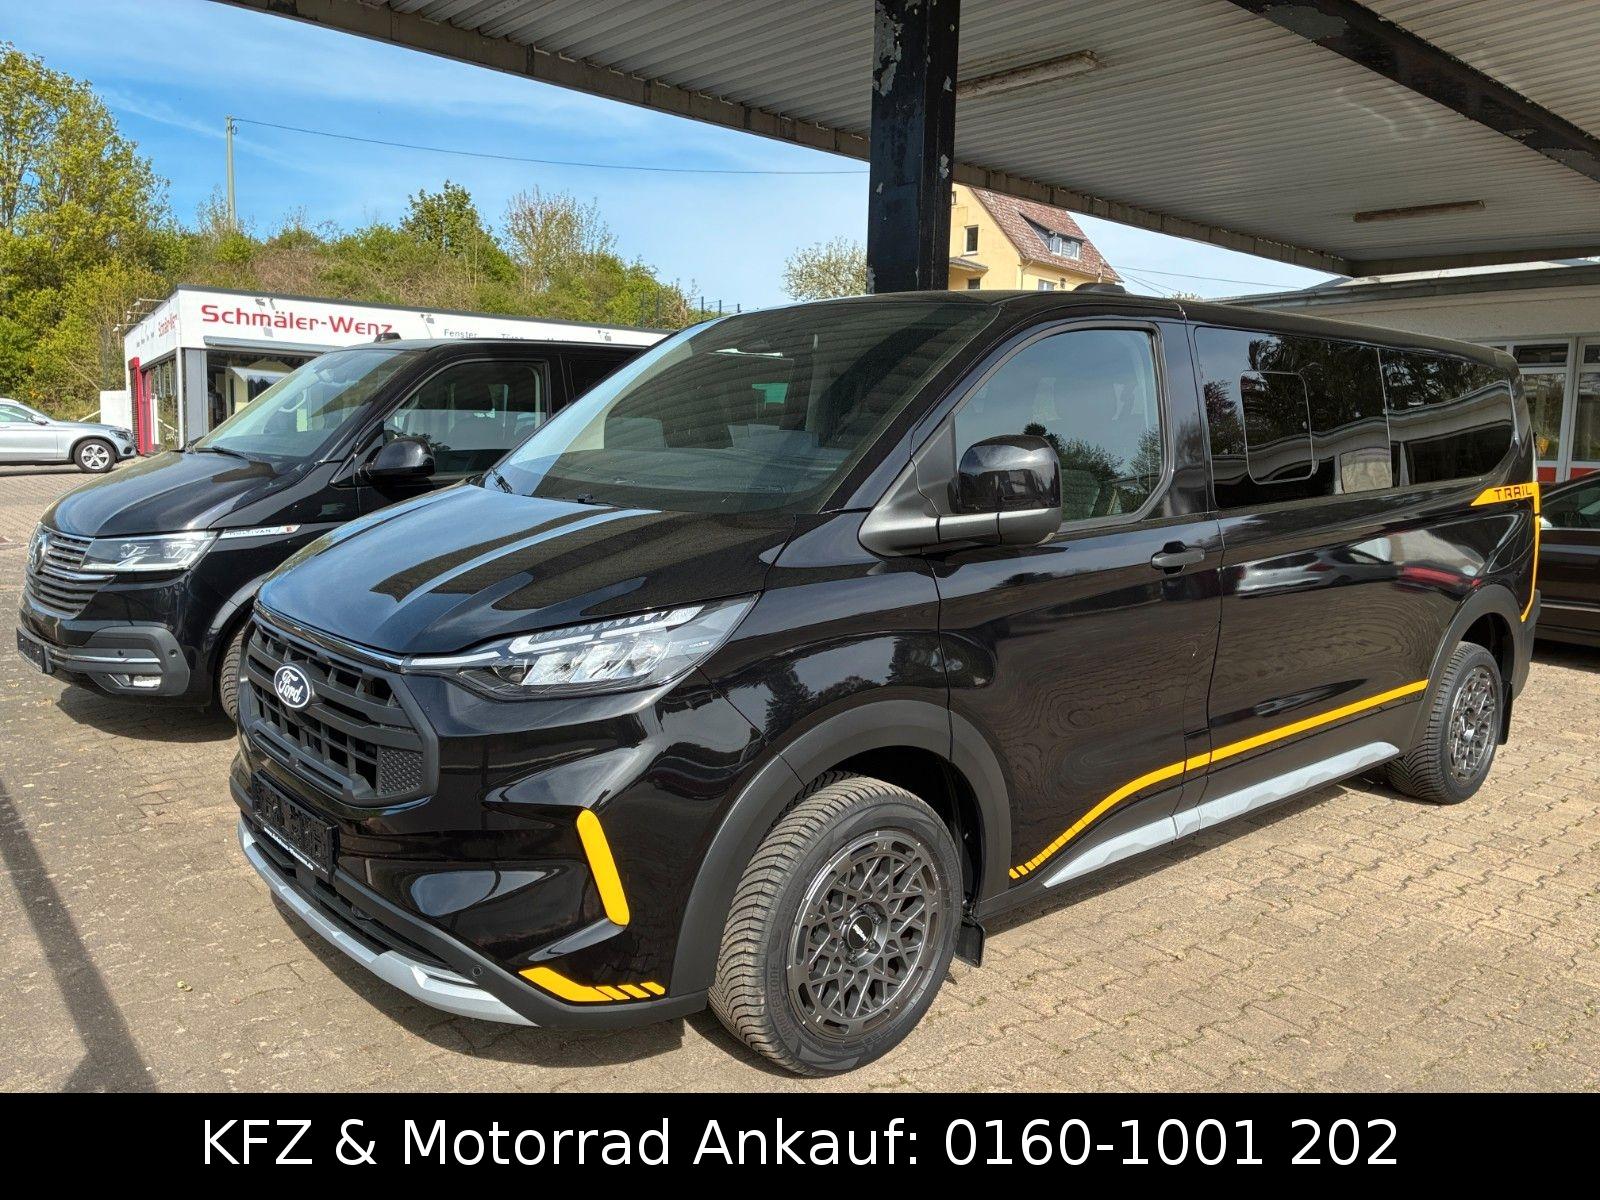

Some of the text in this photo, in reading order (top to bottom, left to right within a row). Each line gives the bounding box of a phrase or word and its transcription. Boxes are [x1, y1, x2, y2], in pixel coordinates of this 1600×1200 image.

[201, 304, 393, 336] Schmäler-Wenz
[444, 328, 477, 339] Fenster
[1494, 485, 1532, 500] TRAIL
[278, 669, 304, 704] Ford
